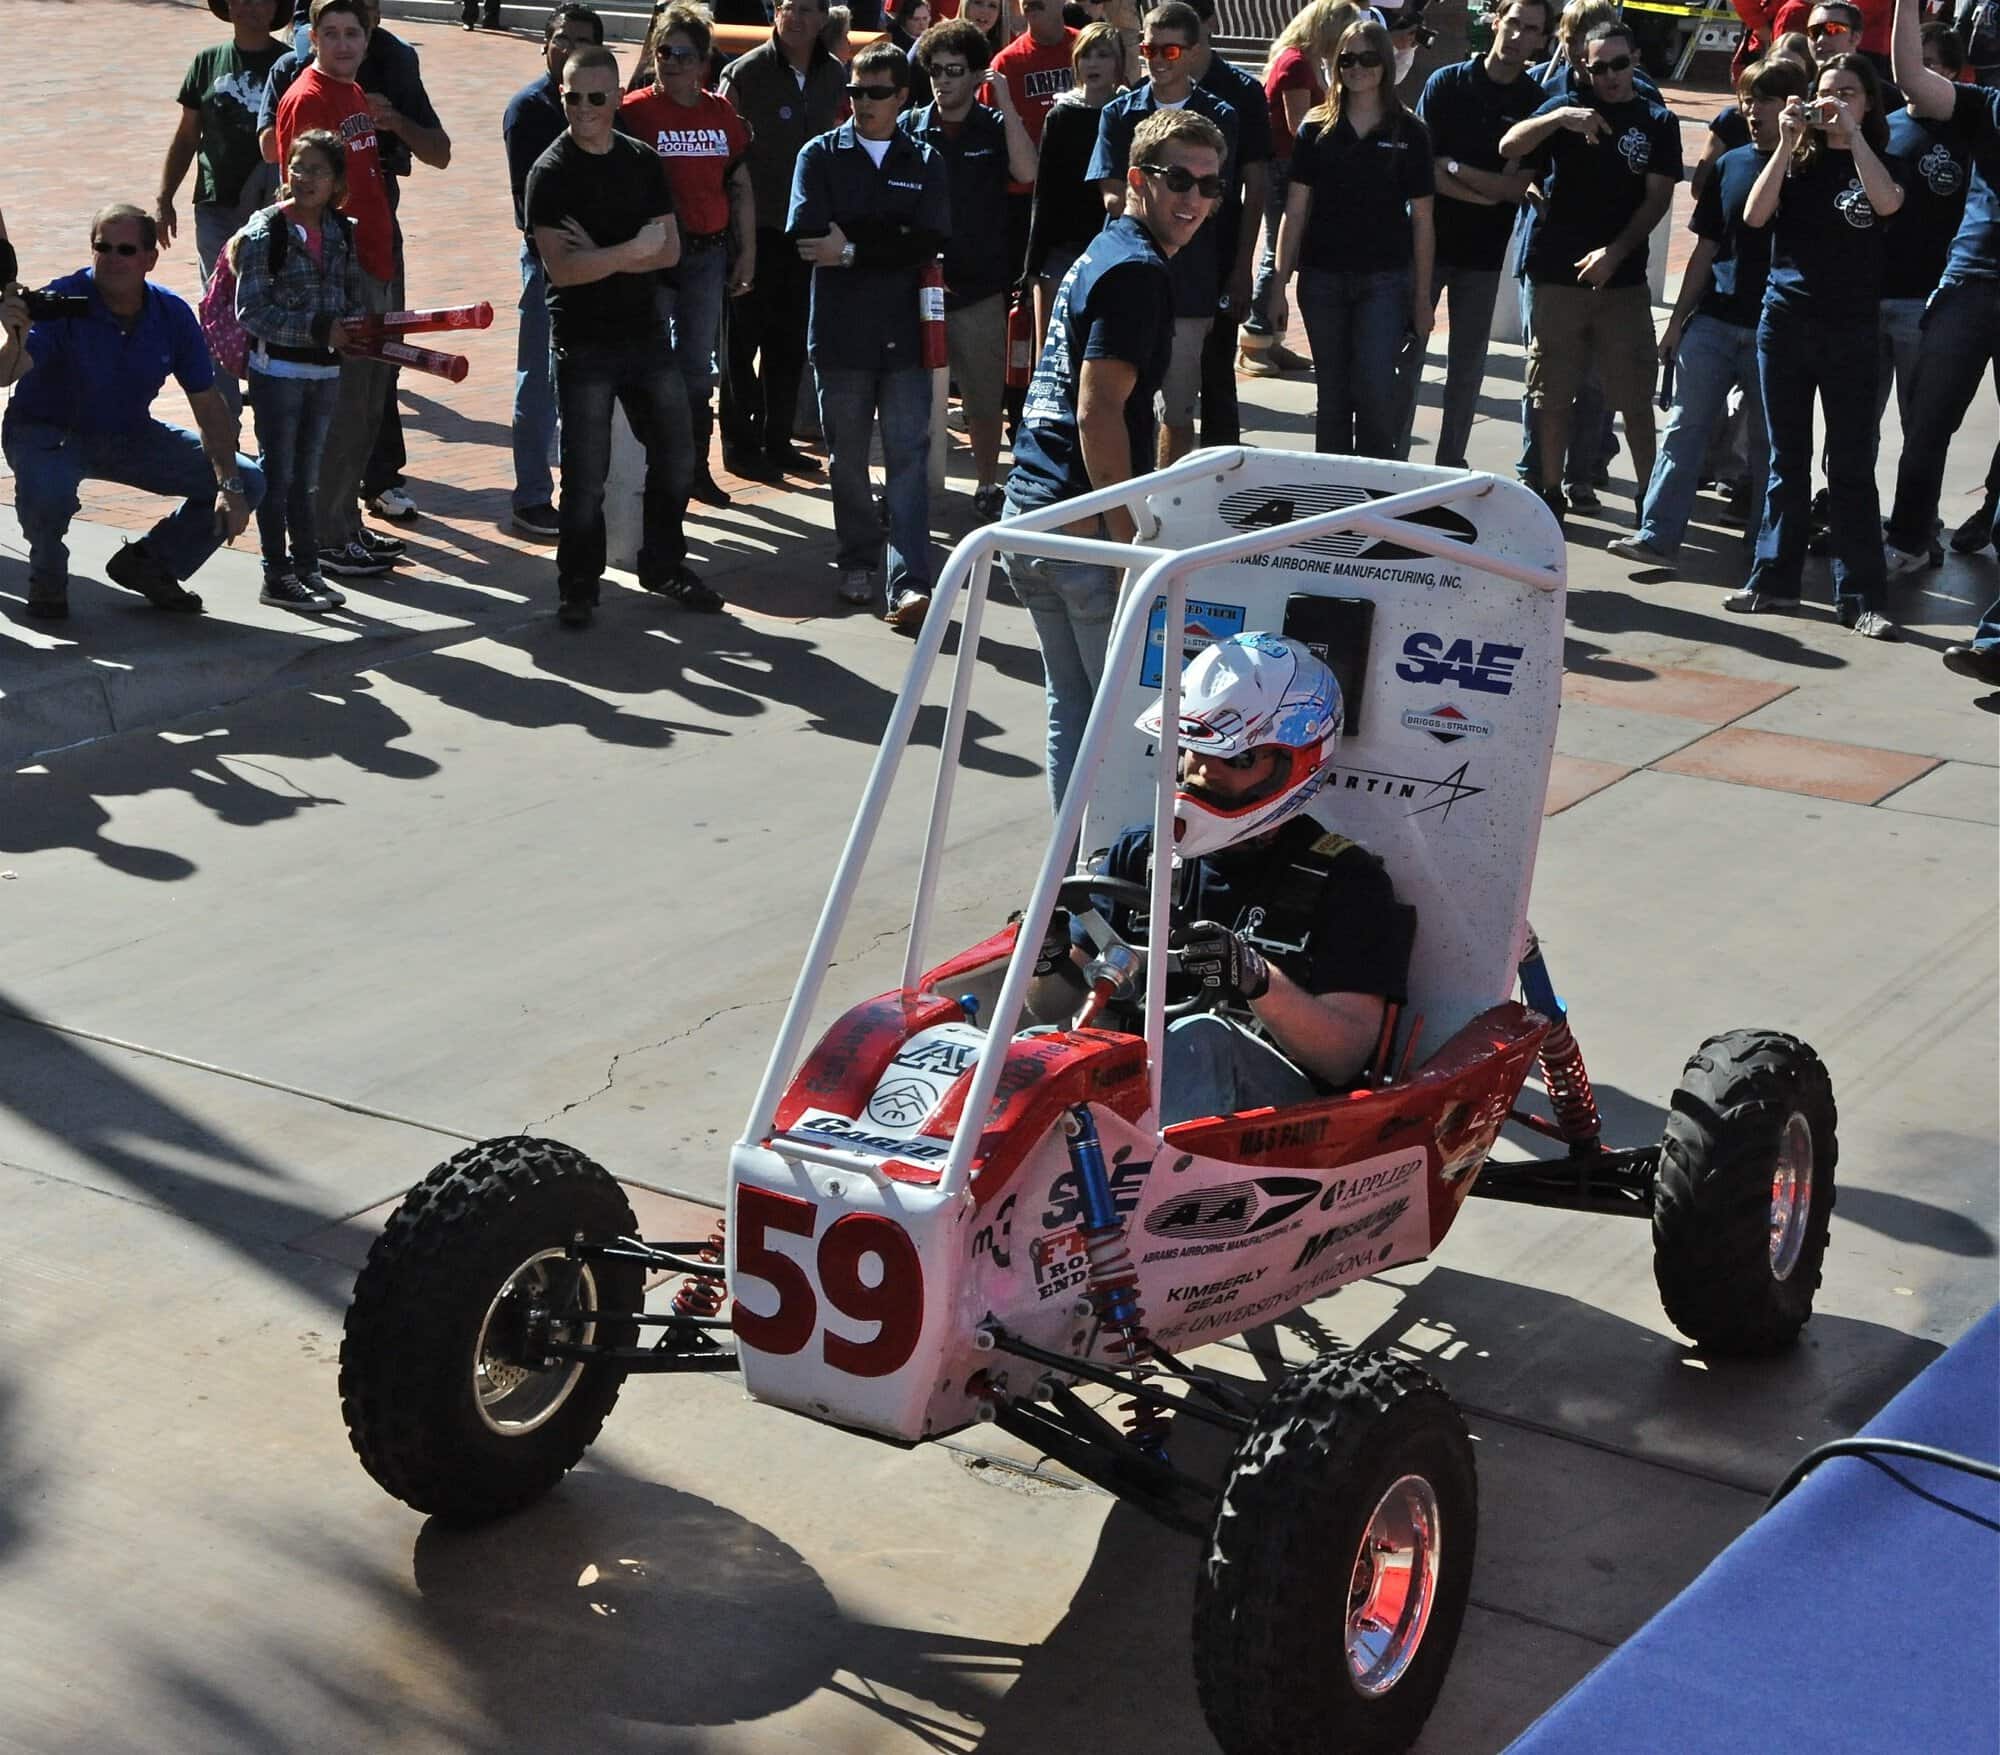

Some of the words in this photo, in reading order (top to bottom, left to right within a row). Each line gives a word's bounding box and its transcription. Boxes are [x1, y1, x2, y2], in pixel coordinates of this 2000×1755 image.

[657, 129, 727, 143] ARIZONA
[657, 142, 716, 152] FOOTBALL
[1270, 555, 1331, 574] AIRBORNE
[1333, 563, 1437, 588] MANUFACTURING,
[1439, 575, 1463, 590] INC.
[1396, 632, 1524, 695] SAE
[1407, 715, 1441, 728] BRIGGS
[1447, 719, 1489, 735] STRATTON
[1326, 772, 1416, 798] ARTIN
[1042, 1161, 1153, 1229] SE
[1342, 1159, 1422, 1201] APPLIED
[1141, 1248, 1179, 1264] ABRAMS
[1179, 1241, 1226, 1257] AIRBORNE
[732, 1182, 925, 1378] 59
[1167, 1267, 1269, 1303] KIMBERLY
[1184, 1290, 1240, 1314] GEAR
[1188, 1293, 1284, 1333] UNIVERSITY
